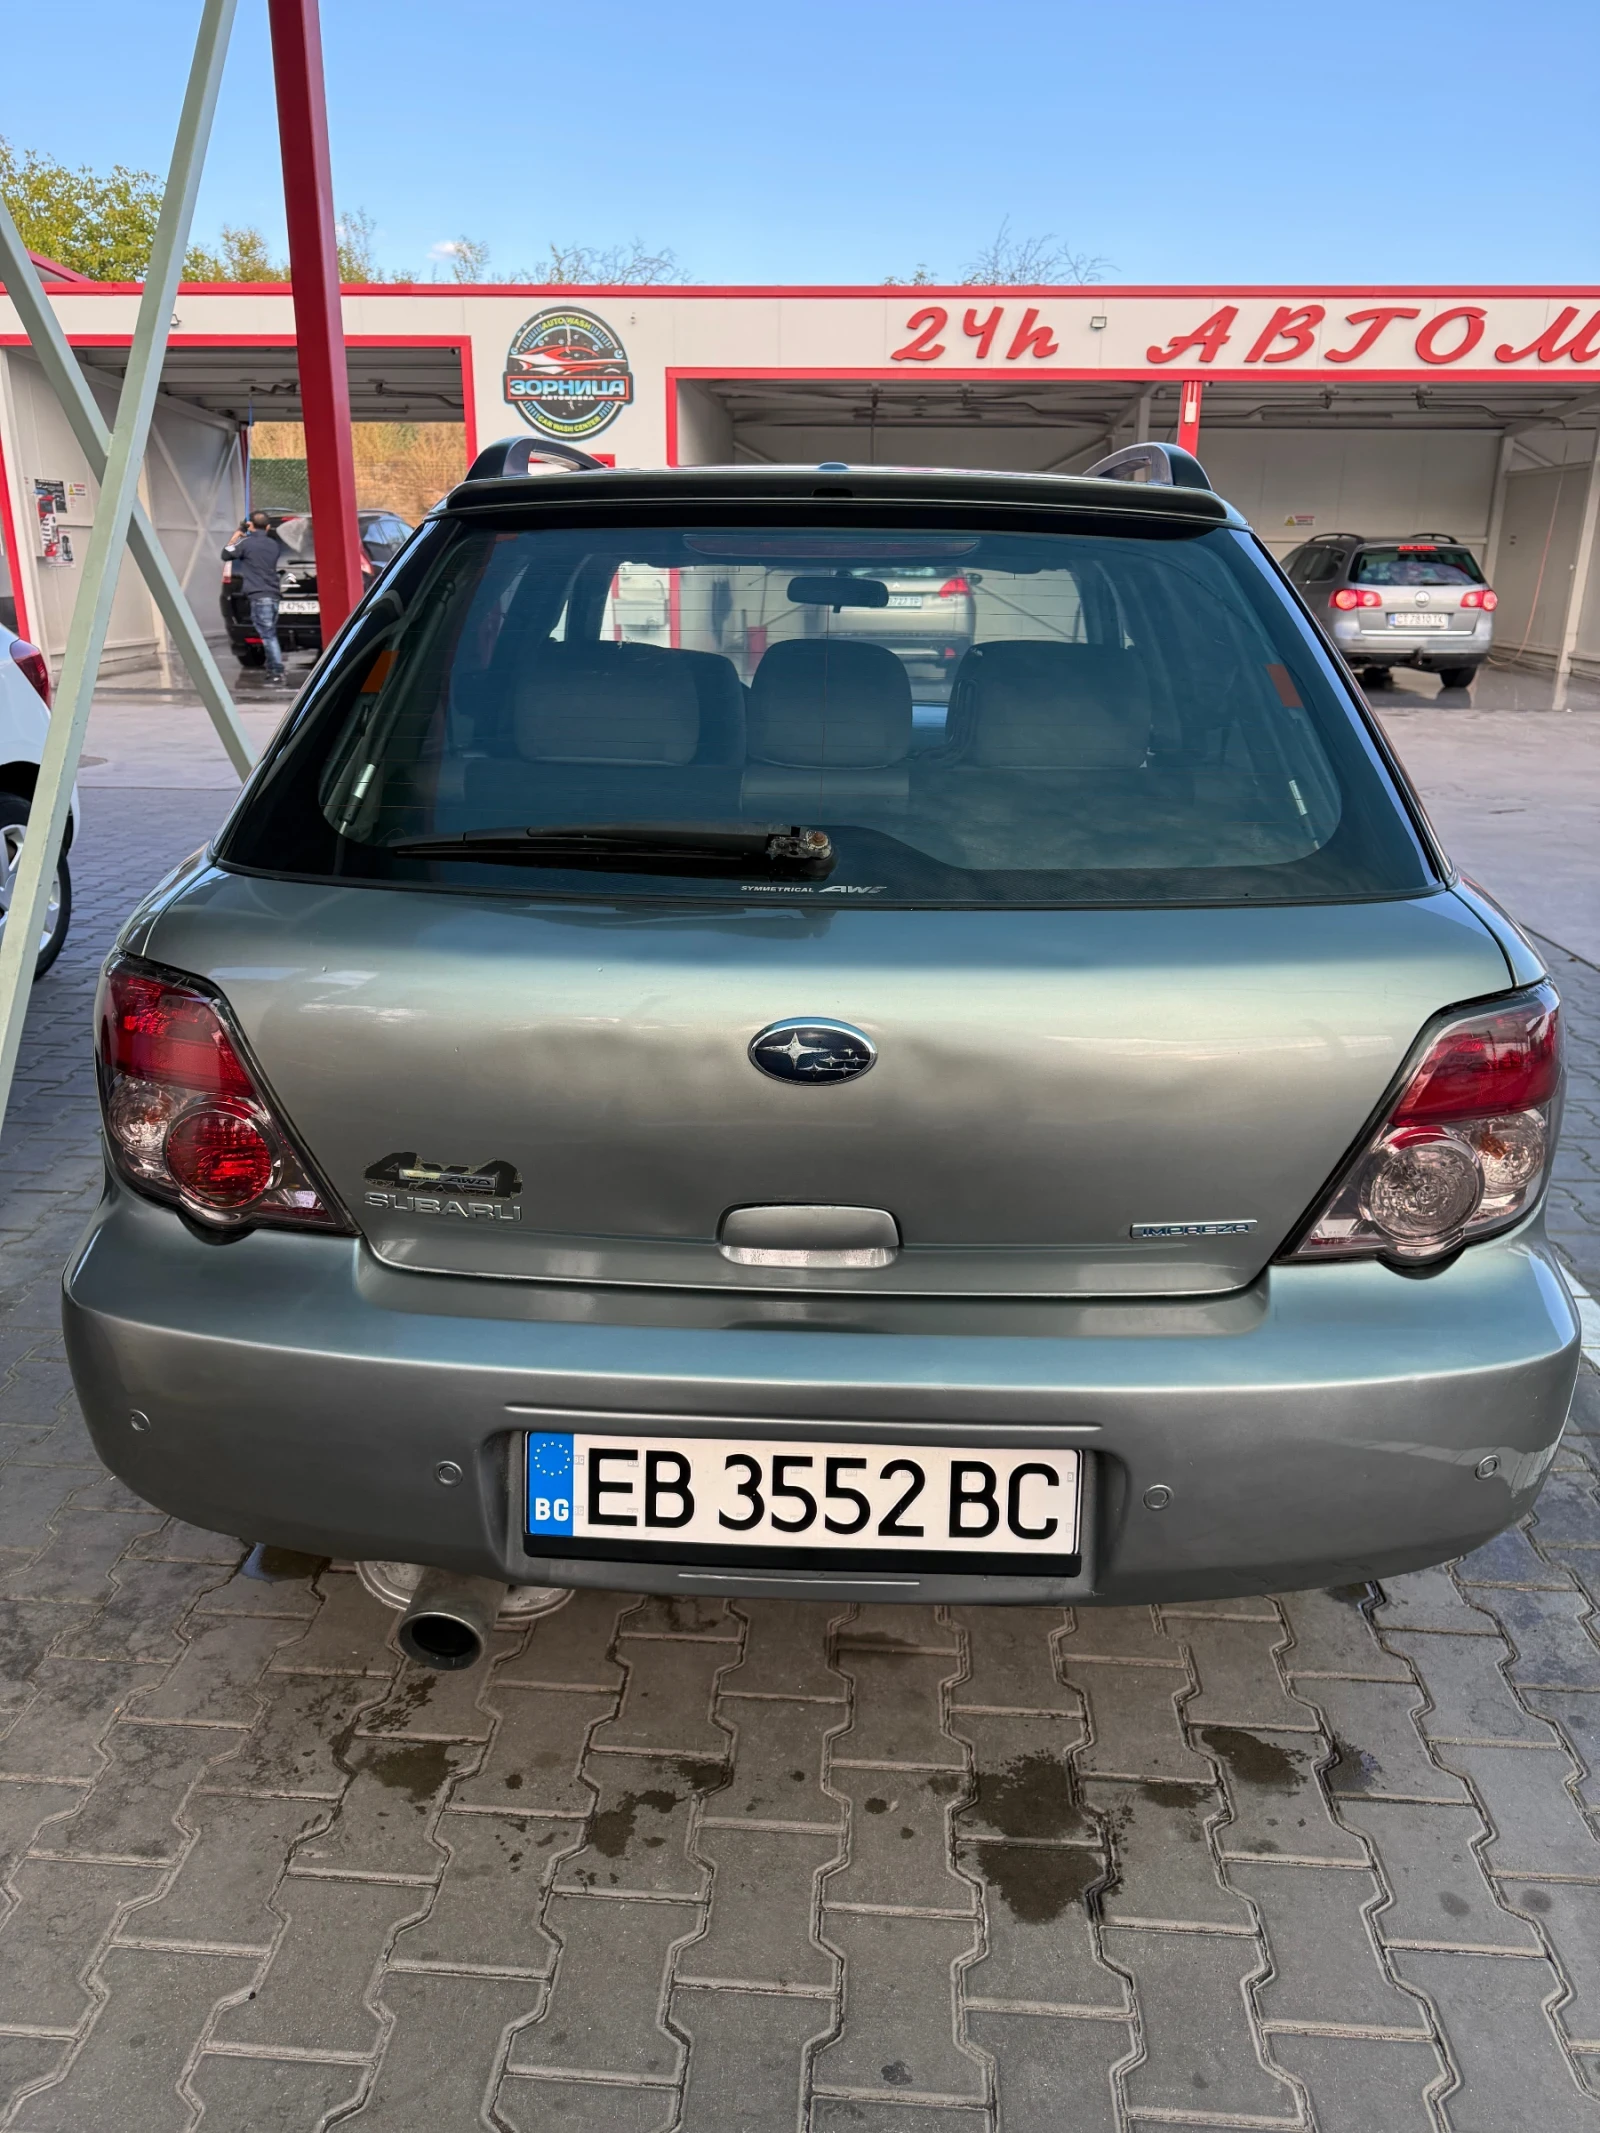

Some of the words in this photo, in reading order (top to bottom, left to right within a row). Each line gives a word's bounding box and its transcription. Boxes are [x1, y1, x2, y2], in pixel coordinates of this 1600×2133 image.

[541, 317, 565, 330] AUTO
[565, 317, 592, 330] WASH
[509, 380, 626, 396] ЗОРНИЦА
[537, 415, 554, 428] CAR
[552, 422, 574, 432] WASH
[573, 415, 602, 432] CENTER
[741, 885, 814, 893] SYMMETRICAL
[364, 1192, 522, 1221] SUBARU
[1142, 1223, 1249, 1237] IMPREZA
[588, 1447, 695, 1528] EB
[718, 1453, 926, 1537] 3552
[947, 1460, 1060, 1540] BC
[534, 1497, 570, 1522] BG
